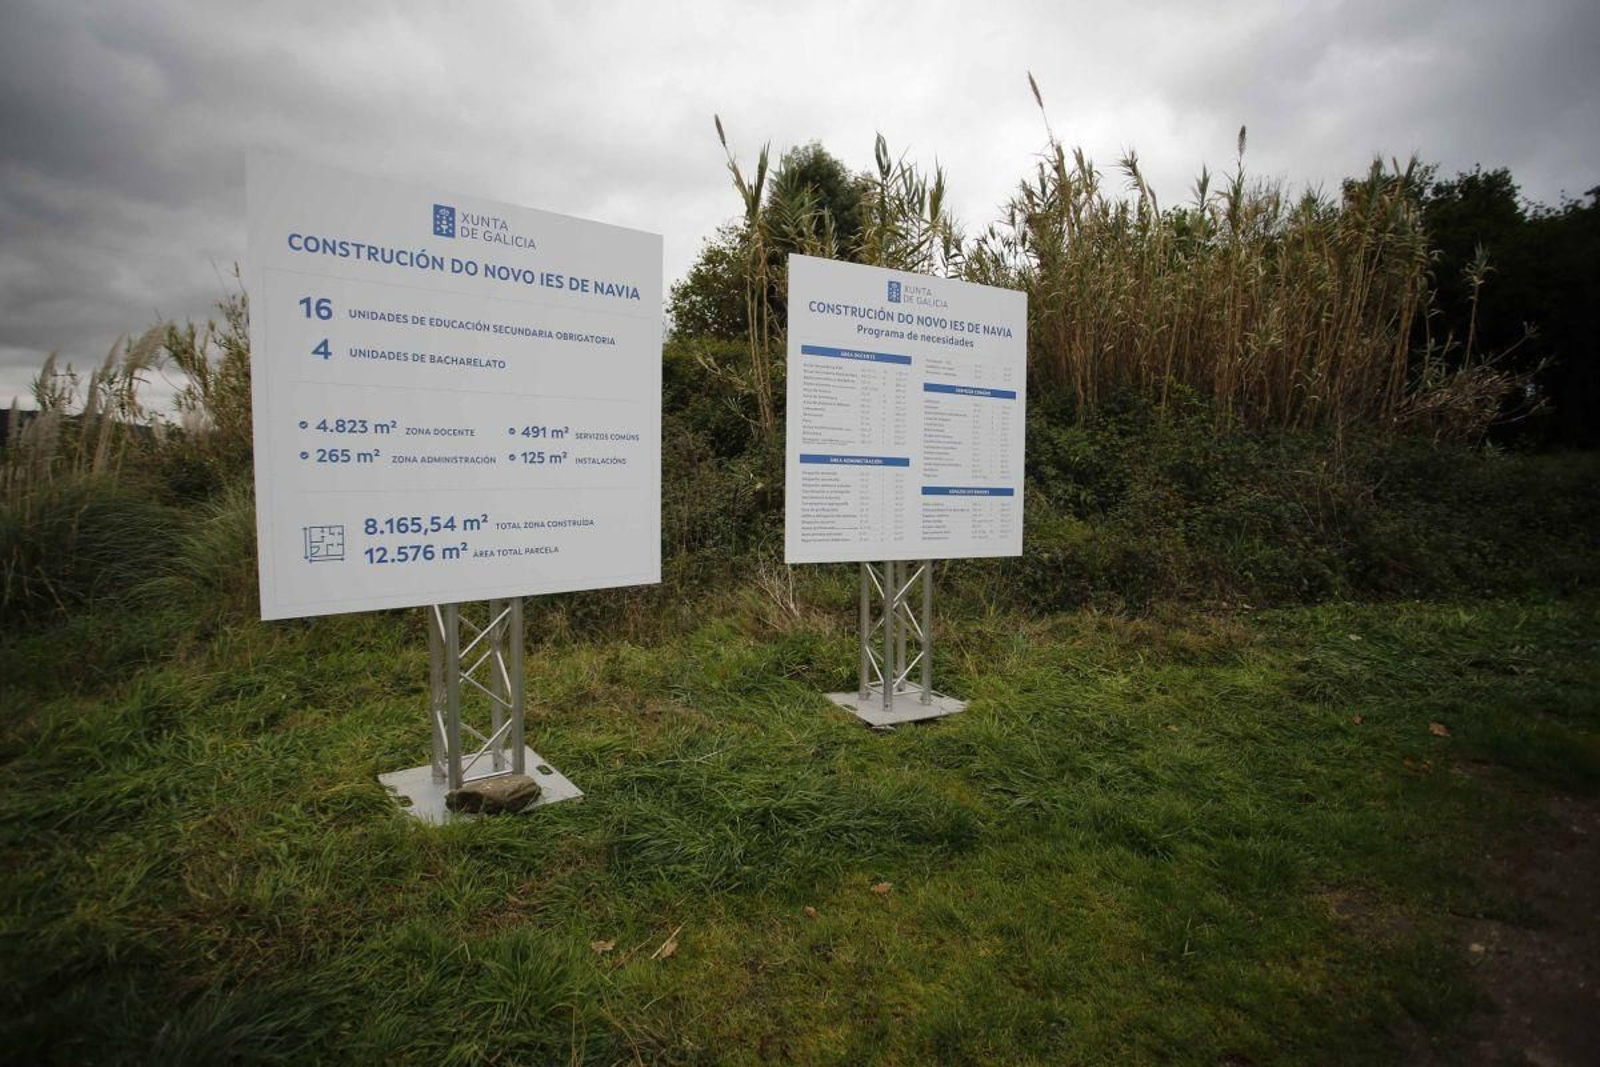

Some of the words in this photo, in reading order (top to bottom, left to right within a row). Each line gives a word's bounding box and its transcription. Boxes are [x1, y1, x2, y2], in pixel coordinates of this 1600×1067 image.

[460, 212, 509, 231] XUNTA
[460, 226, 478, 240] DE
[483, 230, 537, 250] GALICIA
[288, 233, 445, 272] CONSTRUCIÓN
[451, 259, 478, 276] DO
[484, 263, 536, 285] NOVO
[540, 273, 564, 290] IES
[568, 277, 590, 293] DE
[594, 280, 641, 300] NAVIA
[904, 285, 932, 296] XUNTA
[298, 296, 333, 321] 16
[903, 295, 914, 304] DE
[916, 298, 948, 308] GALICIA
[348, 308, 409, 325] UNIDADES
[411, 315, 426, 326] DE
[428, 315, 490, 332] EDUCACIÓN
[492, 324, 553, 339] SECUNDARIA
[556, 330, 616, 346] OBRIGATORIA
[809, 301, 894, 321] CONSTRUCIÓN
[898, 313, 914, 325] DO
[917, 316, 947, 329] NOVO
[950, 321, 964, 331] IES
[968, 323, 980, 333] DE
[984, 325, 1012, 338] NAVIA
[857, 325, 905, 340] Programa
[907, 330, 918, 341] de
[921, 333, 974, 348] necesidades
[311, 338, 332, 360] 4
[349, 348, 409, 362] UNIDADES
[411, 353, 426, 363] DE
[429, 354, 506, 369] BACHARELATO
[316, 419, 368, 434] 4.823
[405, 427, 431, 436] ZONA
[433, 428, 475, 437] DOCENTE
[521, 425, 546, 439] 491
[575, 432, 608, 441] SERVIZOS
[316, 449, 351, 464] 265
[392, 455, 418, 464] ZONA
[420, 454, 496, 464] ADMINISTRACIÓN
[520, 451, 546, 464] 125
[575, 456, 626, 465] INSTALACIÓNS
[364, 516, 457, 536] 8.165,54
[495, 521, 520, 530] TOTAL
[523, 520, 545, 529] ZONA
[364, 546, 435, 564] 12.576
[473, 548, 493, 558] ÁREA
[495, 549, 523, 557] TOTAL
[525, 546, 559, 556] PARCELA
